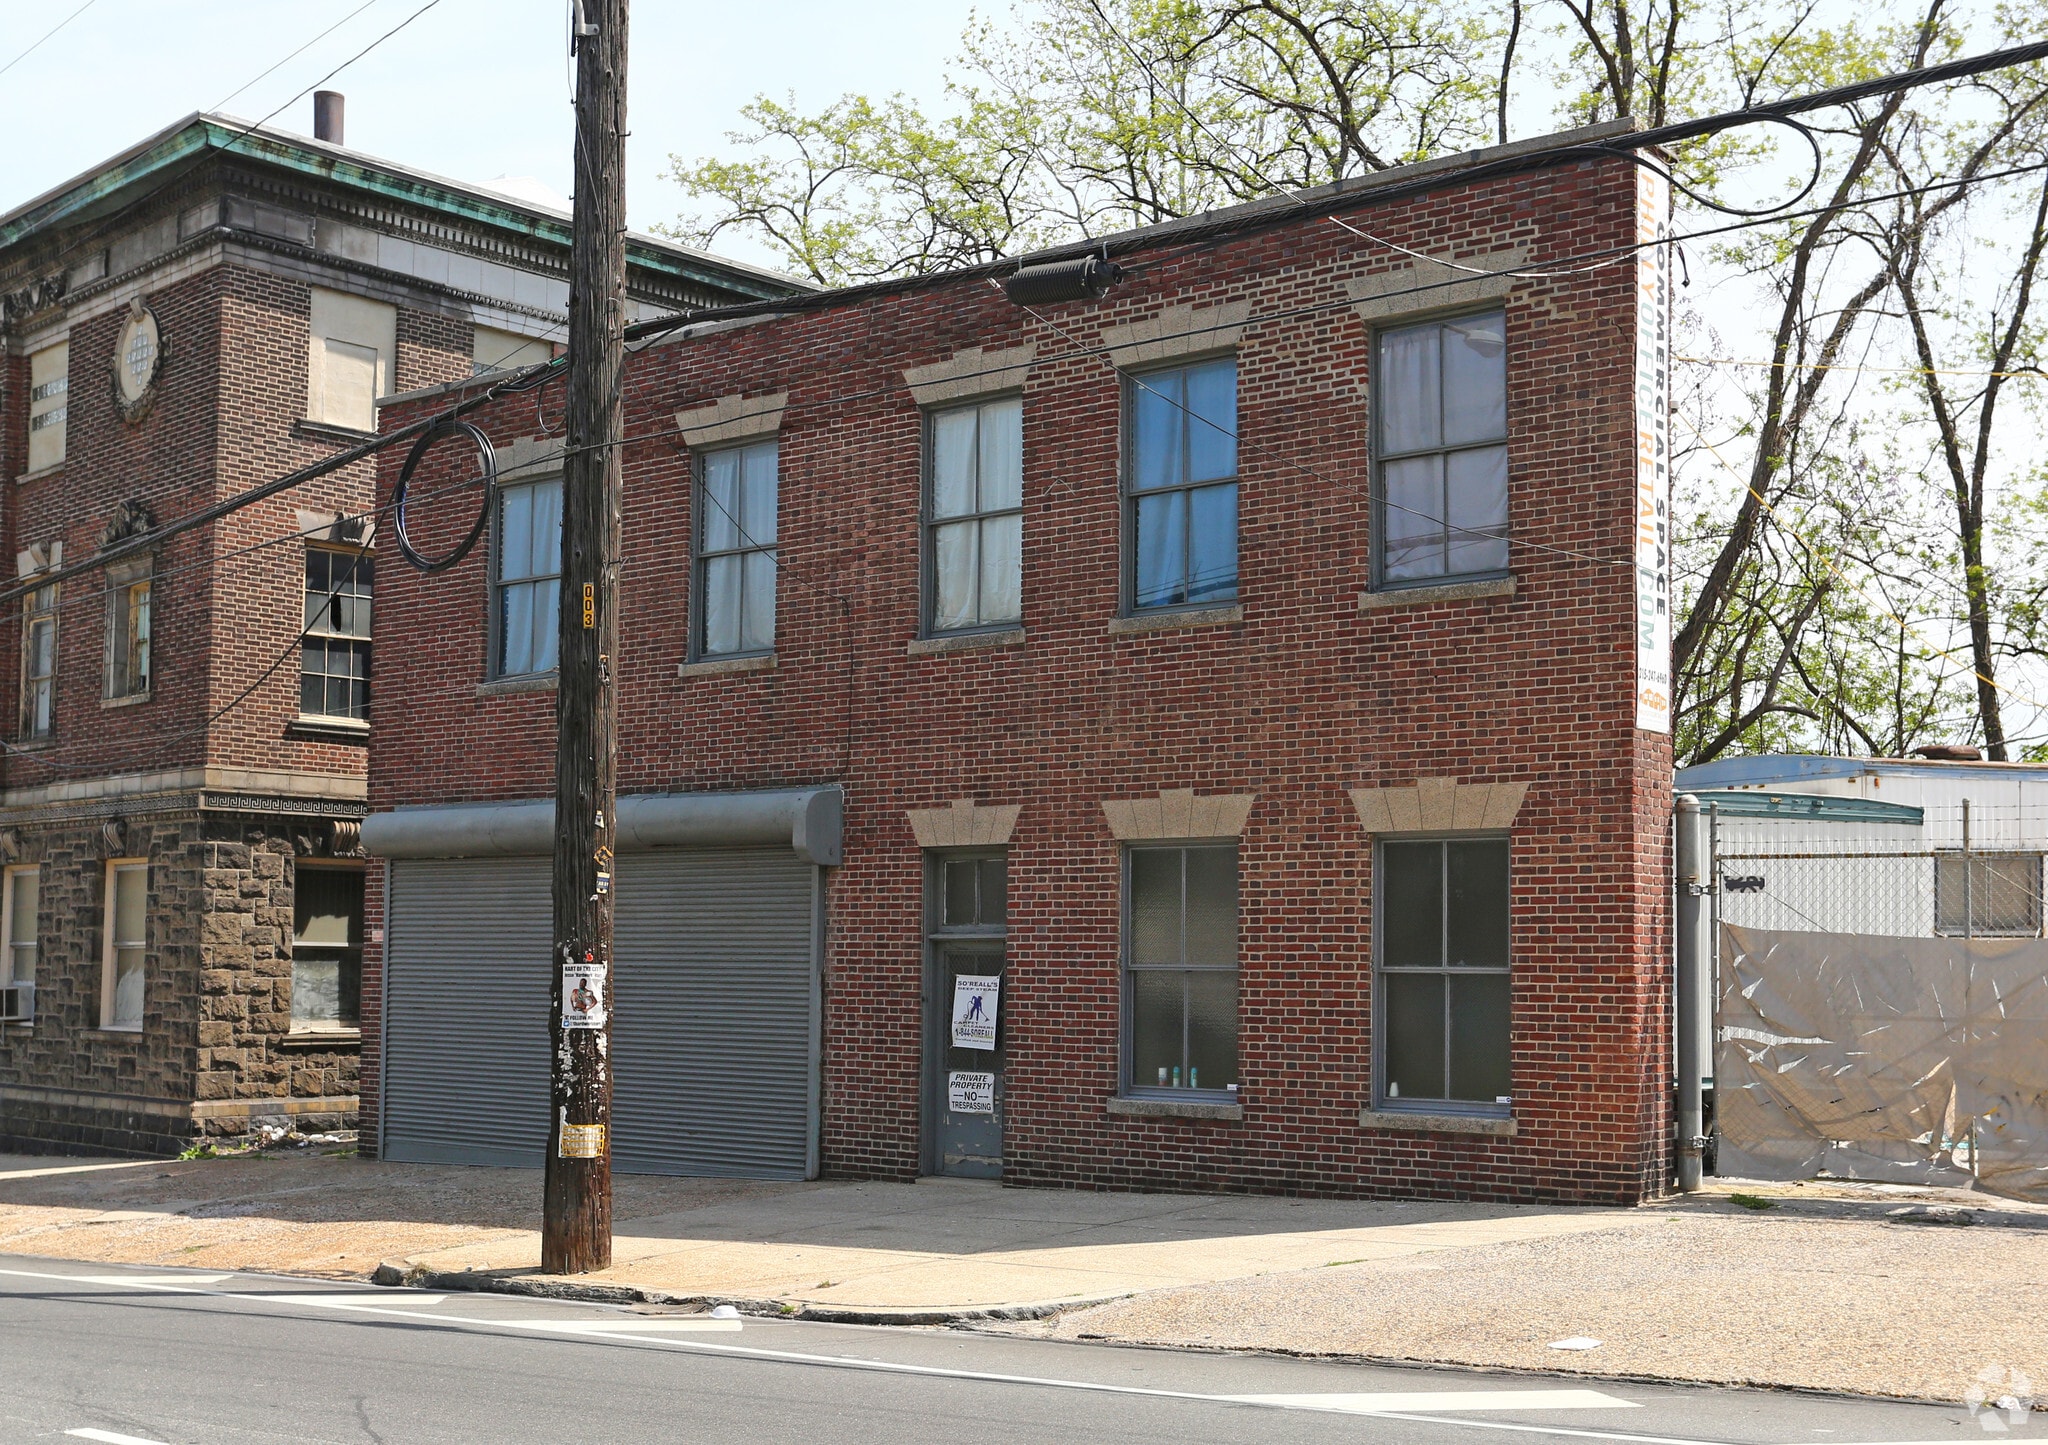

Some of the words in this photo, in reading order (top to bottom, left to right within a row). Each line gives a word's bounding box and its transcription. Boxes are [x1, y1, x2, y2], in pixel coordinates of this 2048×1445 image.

[1656, 221, 1665, 479] COMMERCIAL
[1656, 498, 1666, 616] SPACE
[955, 1074, 988, 1082] PRIVATE
[950, 1081, 993, 1090] PROPERTY
[964, 1091, 978, 1101] NO
[952, 1101, 992, 1110] TRESPASSING
